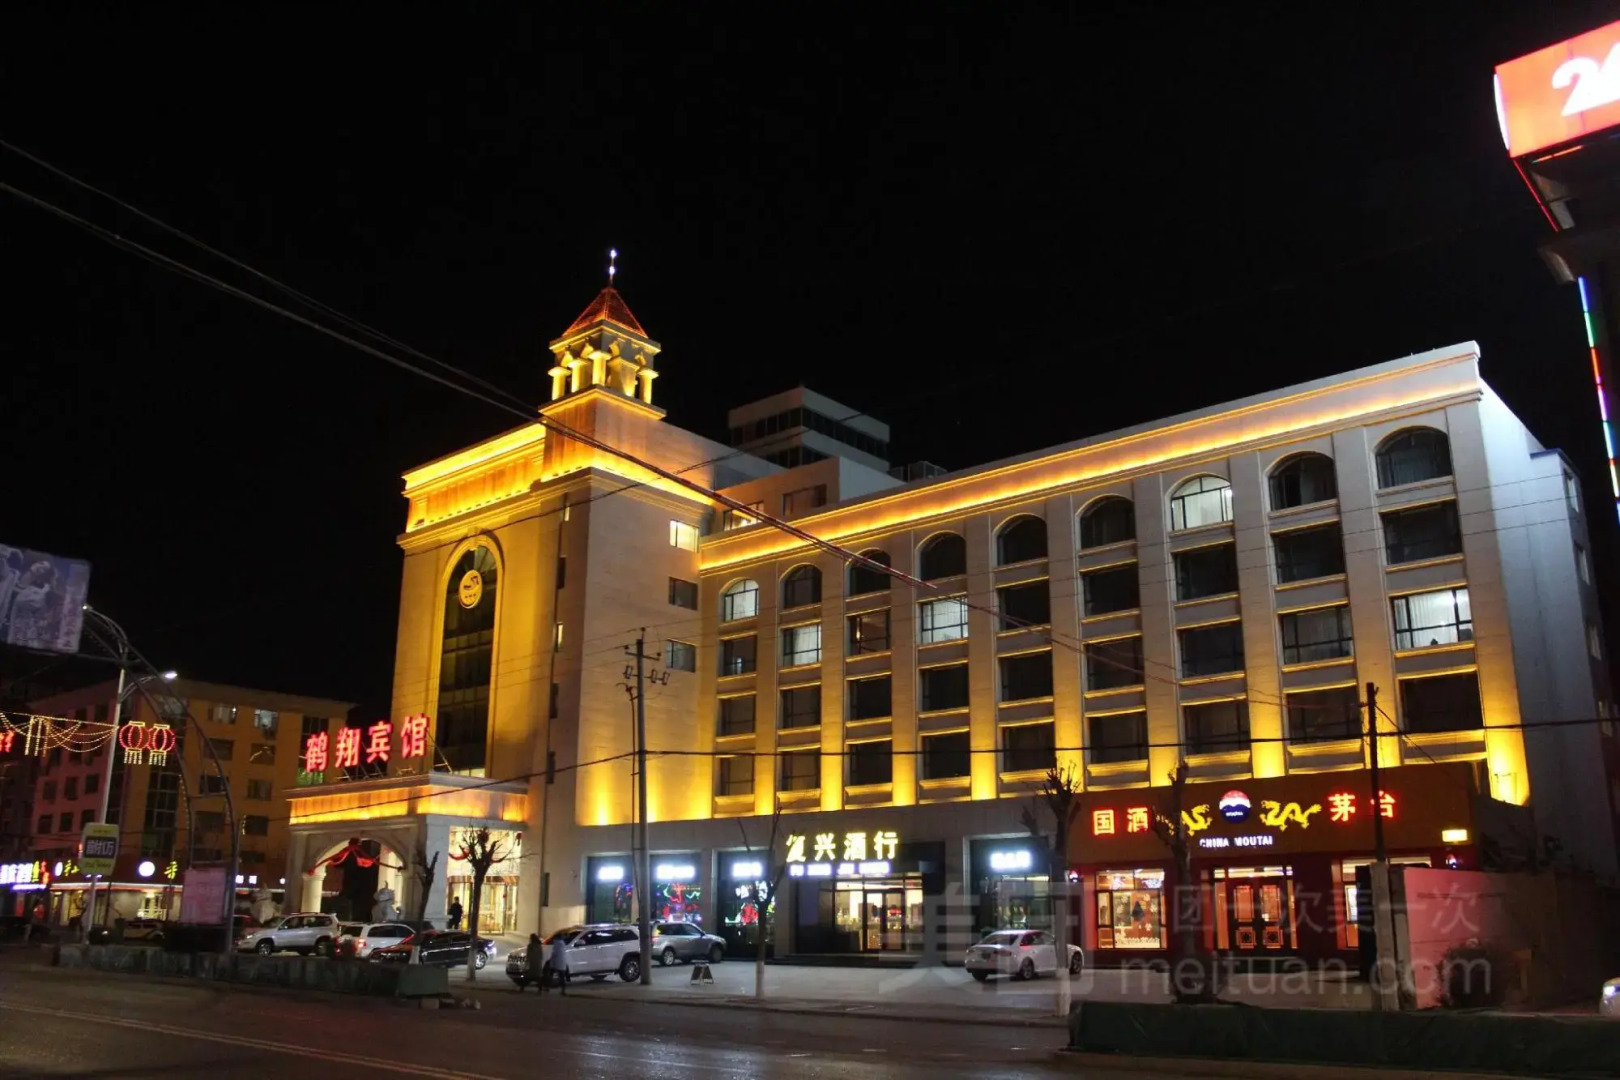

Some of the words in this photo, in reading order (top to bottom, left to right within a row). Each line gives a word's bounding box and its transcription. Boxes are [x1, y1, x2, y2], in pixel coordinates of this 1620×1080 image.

[306, 713, 429, 773] 鹤翔宾馆
[1093, 807, 1149, 836] 国酒
[1327, 790, 1396, 822] 茅台
[786, 831, 899, 862] 复兴酒行
[1199, 836, 1230, 848] CHINA
[1233, 835, 1273, 847] MOUTAI
